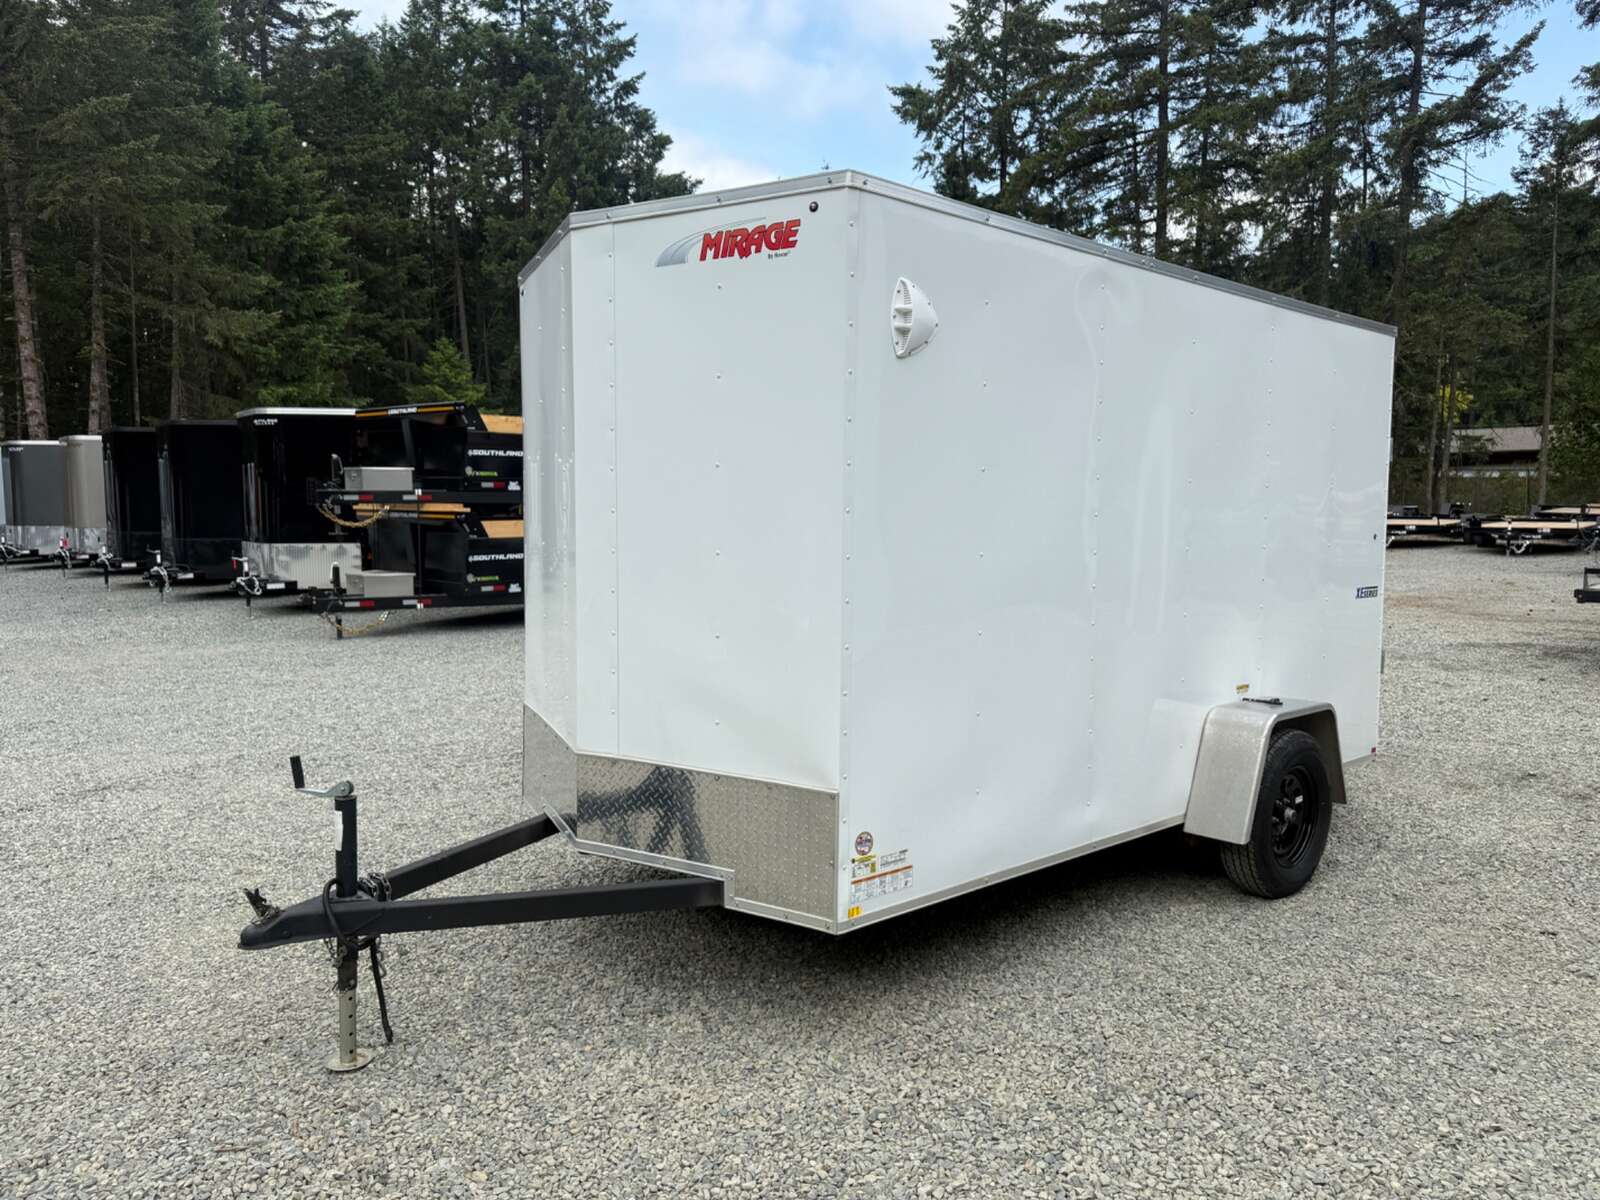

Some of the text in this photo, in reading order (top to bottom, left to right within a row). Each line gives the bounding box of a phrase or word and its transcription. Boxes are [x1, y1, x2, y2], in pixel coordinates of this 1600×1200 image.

[699, 218, 801, 261] MIRAGE
[472, 449, 524, 457] SOUTHLAND
[472, 553, 524, 561] SOUTHLAND
